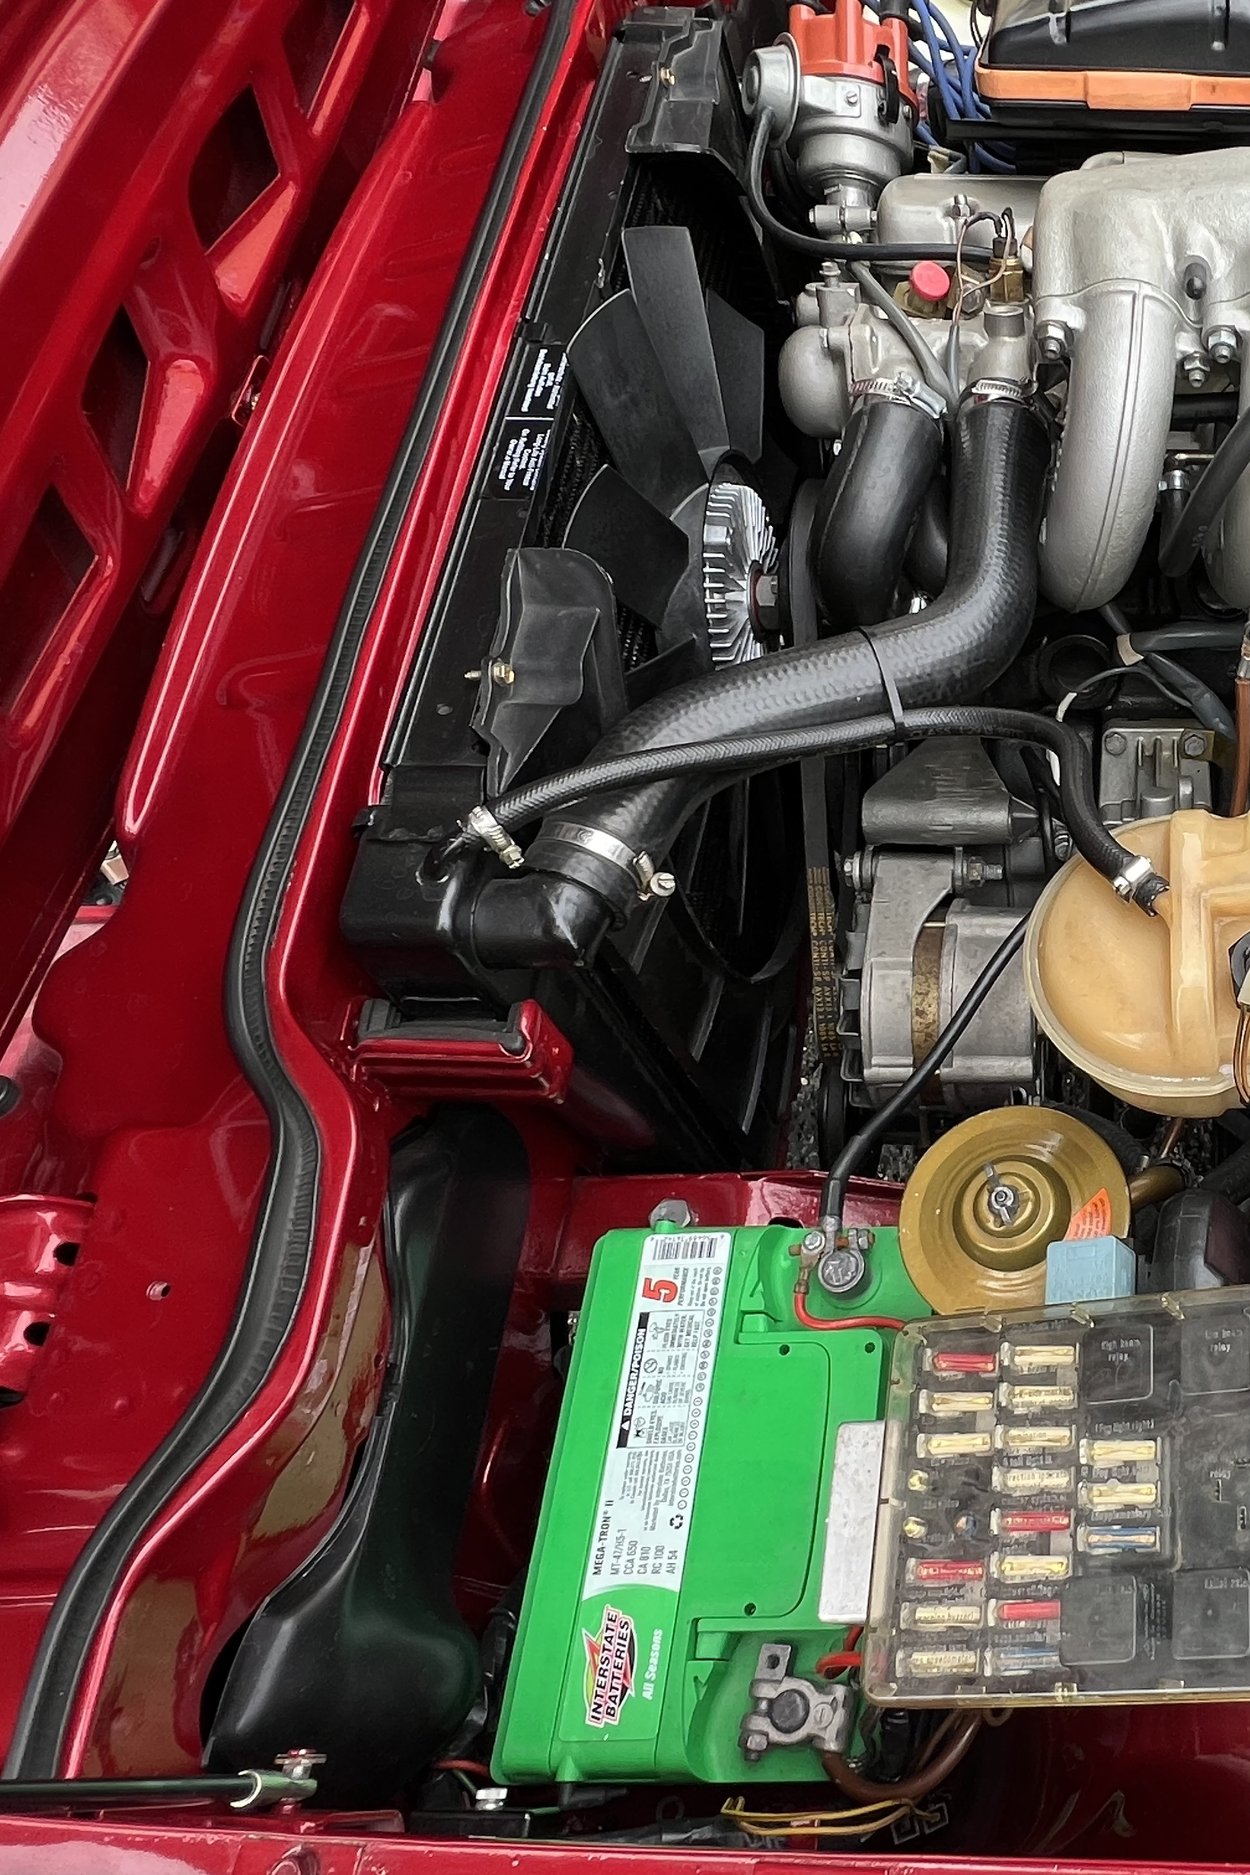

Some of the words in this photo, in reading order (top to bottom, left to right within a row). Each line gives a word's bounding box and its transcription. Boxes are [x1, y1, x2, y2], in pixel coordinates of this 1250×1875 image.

[642, 1277, 678, 1303] 5
[623, 1328, 646, 1416] DANGER/POISON
[668, 1550, 678, 1561] 54
[623, 1559, 634, 1575] CCA
[637, 1563, 648, 1575] CA
[651, 1562, 662, 1574] RC
[666, 1562, 676, 1574] AH
[645, 1628, 664, 1680] Seasons
[590, 1610, 618, 1724] INTERSTATE
[605, 1619, 631, 1718] BATTERIES
[642, 1679, 655, 1701] All
